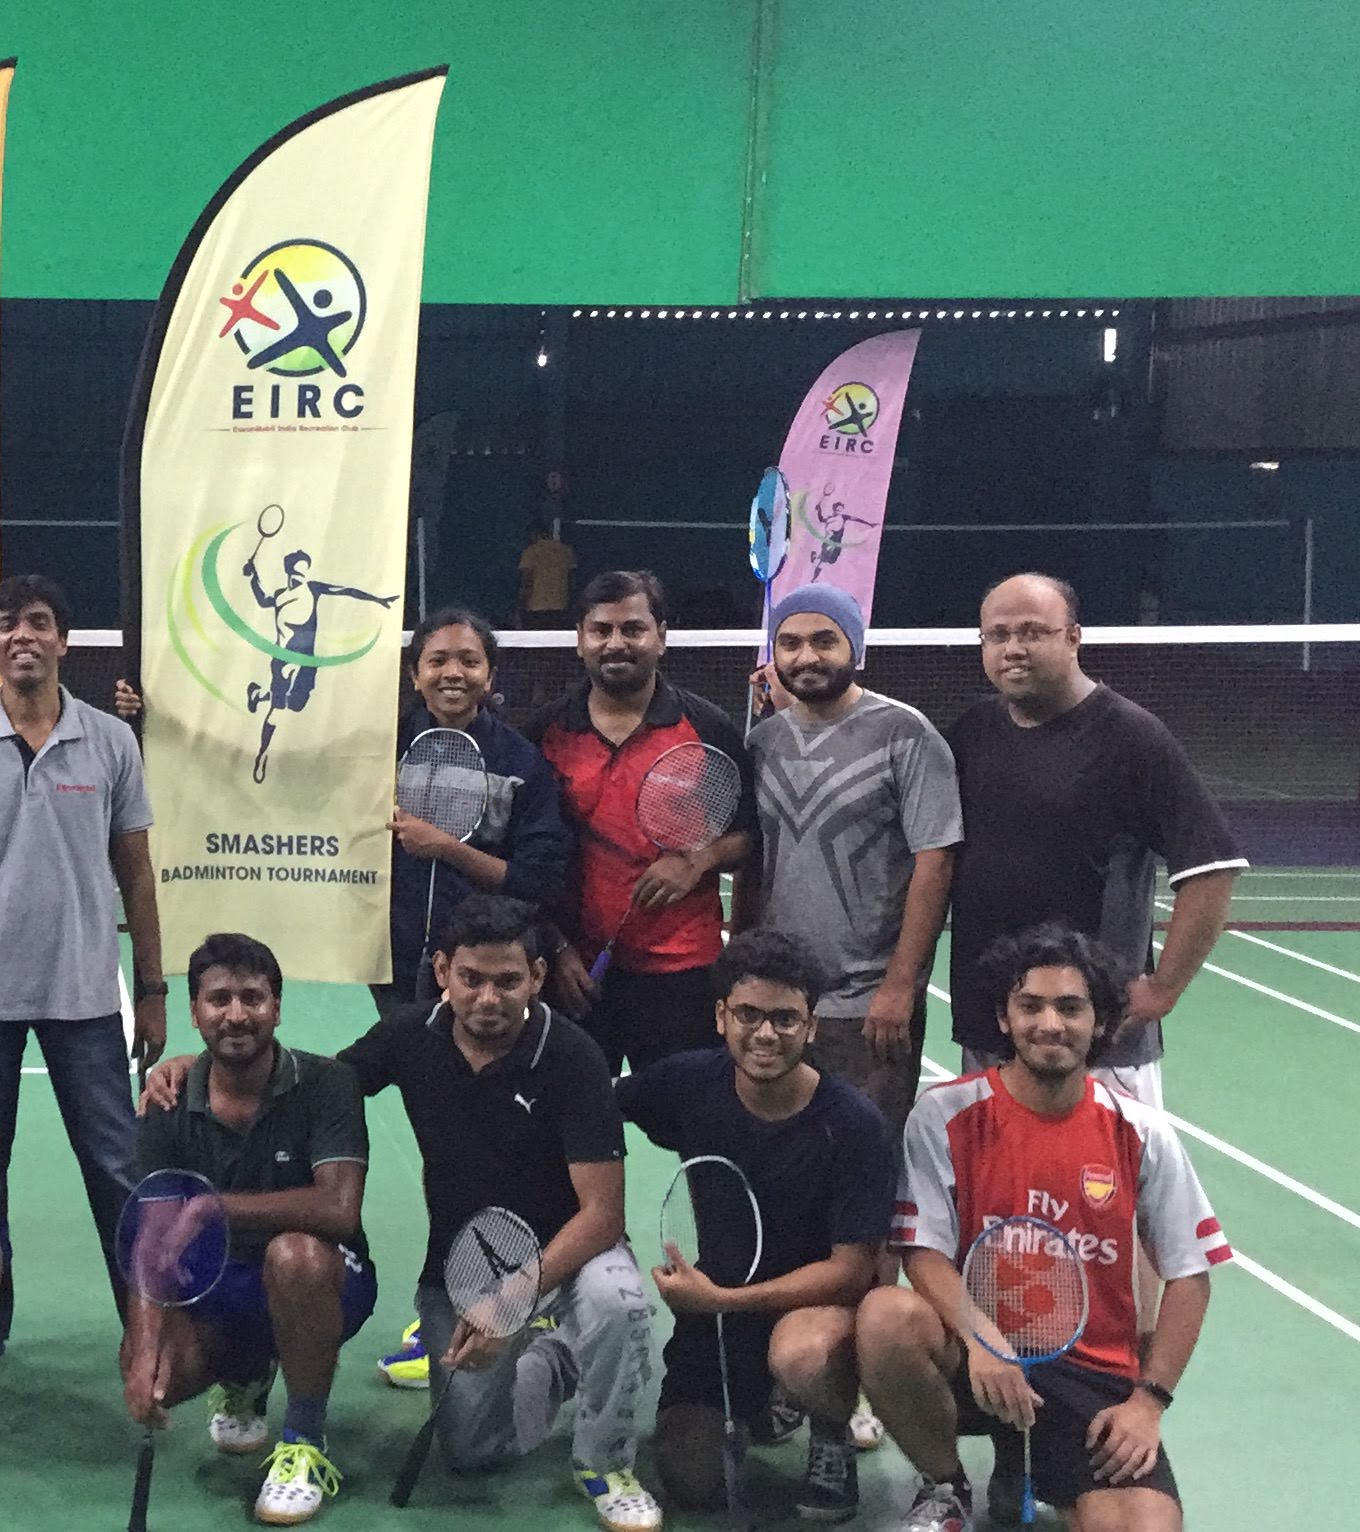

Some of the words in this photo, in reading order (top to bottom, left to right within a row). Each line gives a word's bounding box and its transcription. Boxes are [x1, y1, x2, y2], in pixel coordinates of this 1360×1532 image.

[232, 383, 365, 419] EIRC
[819, 435, 874, 454] EIRC
[205, 832, 340, 857] SMASHERS
[161, 865, 262, 883] BADMINTON
[266, 866, 378, 885] TOURNAMENT
[1027, 1189, 1070, 1222] Fly
